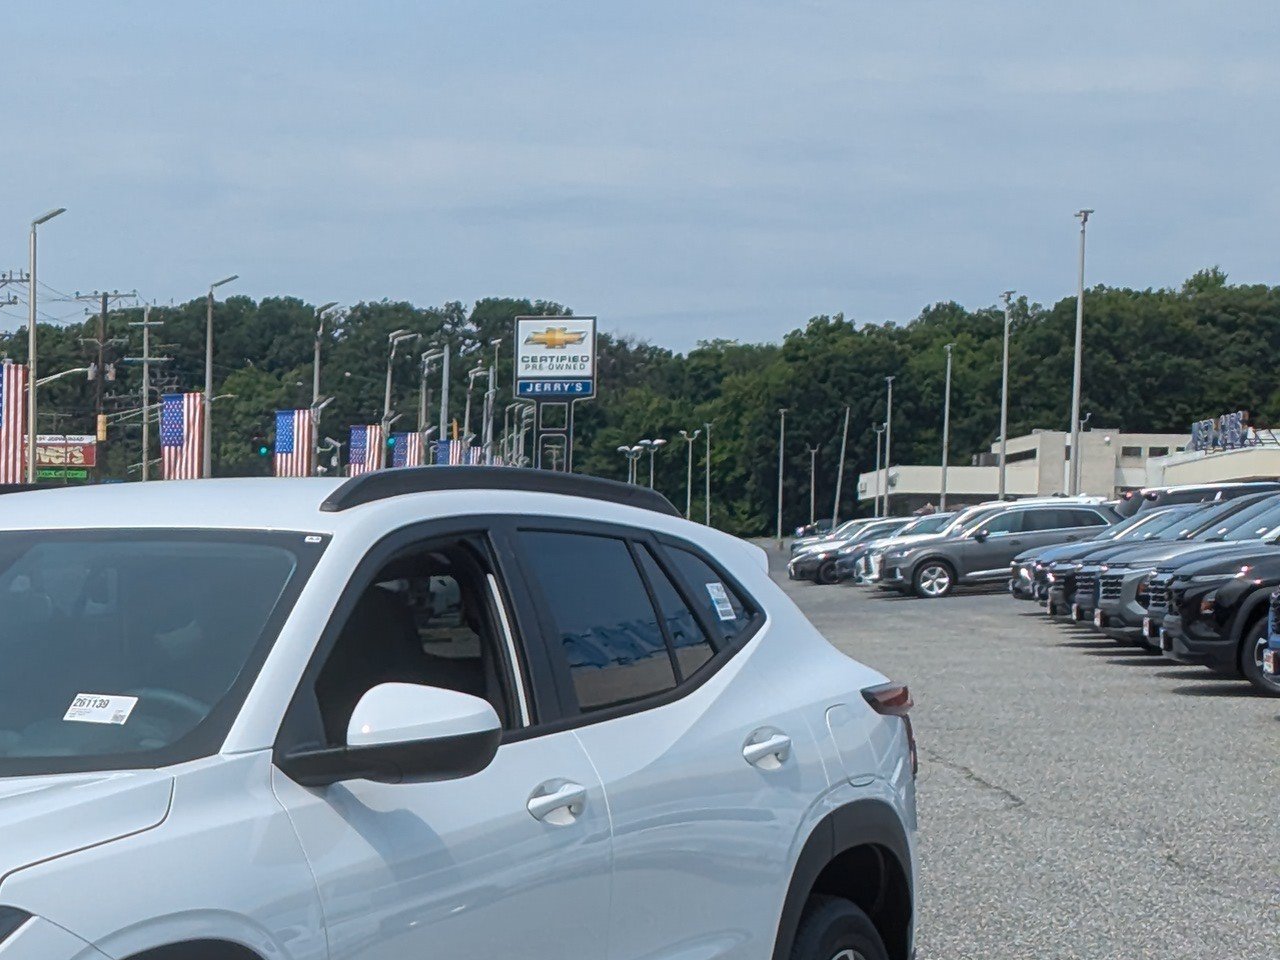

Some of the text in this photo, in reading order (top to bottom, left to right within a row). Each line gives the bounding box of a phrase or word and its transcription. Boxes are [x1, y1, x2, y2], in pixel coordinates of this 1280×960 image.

[521, 355, 590, 363] CERTIFIED
[524, 363, 586, 371] PRE OWNED
[526, 382, 583, 392] JERRY'S
[73, 697, 111, 709] 261139
